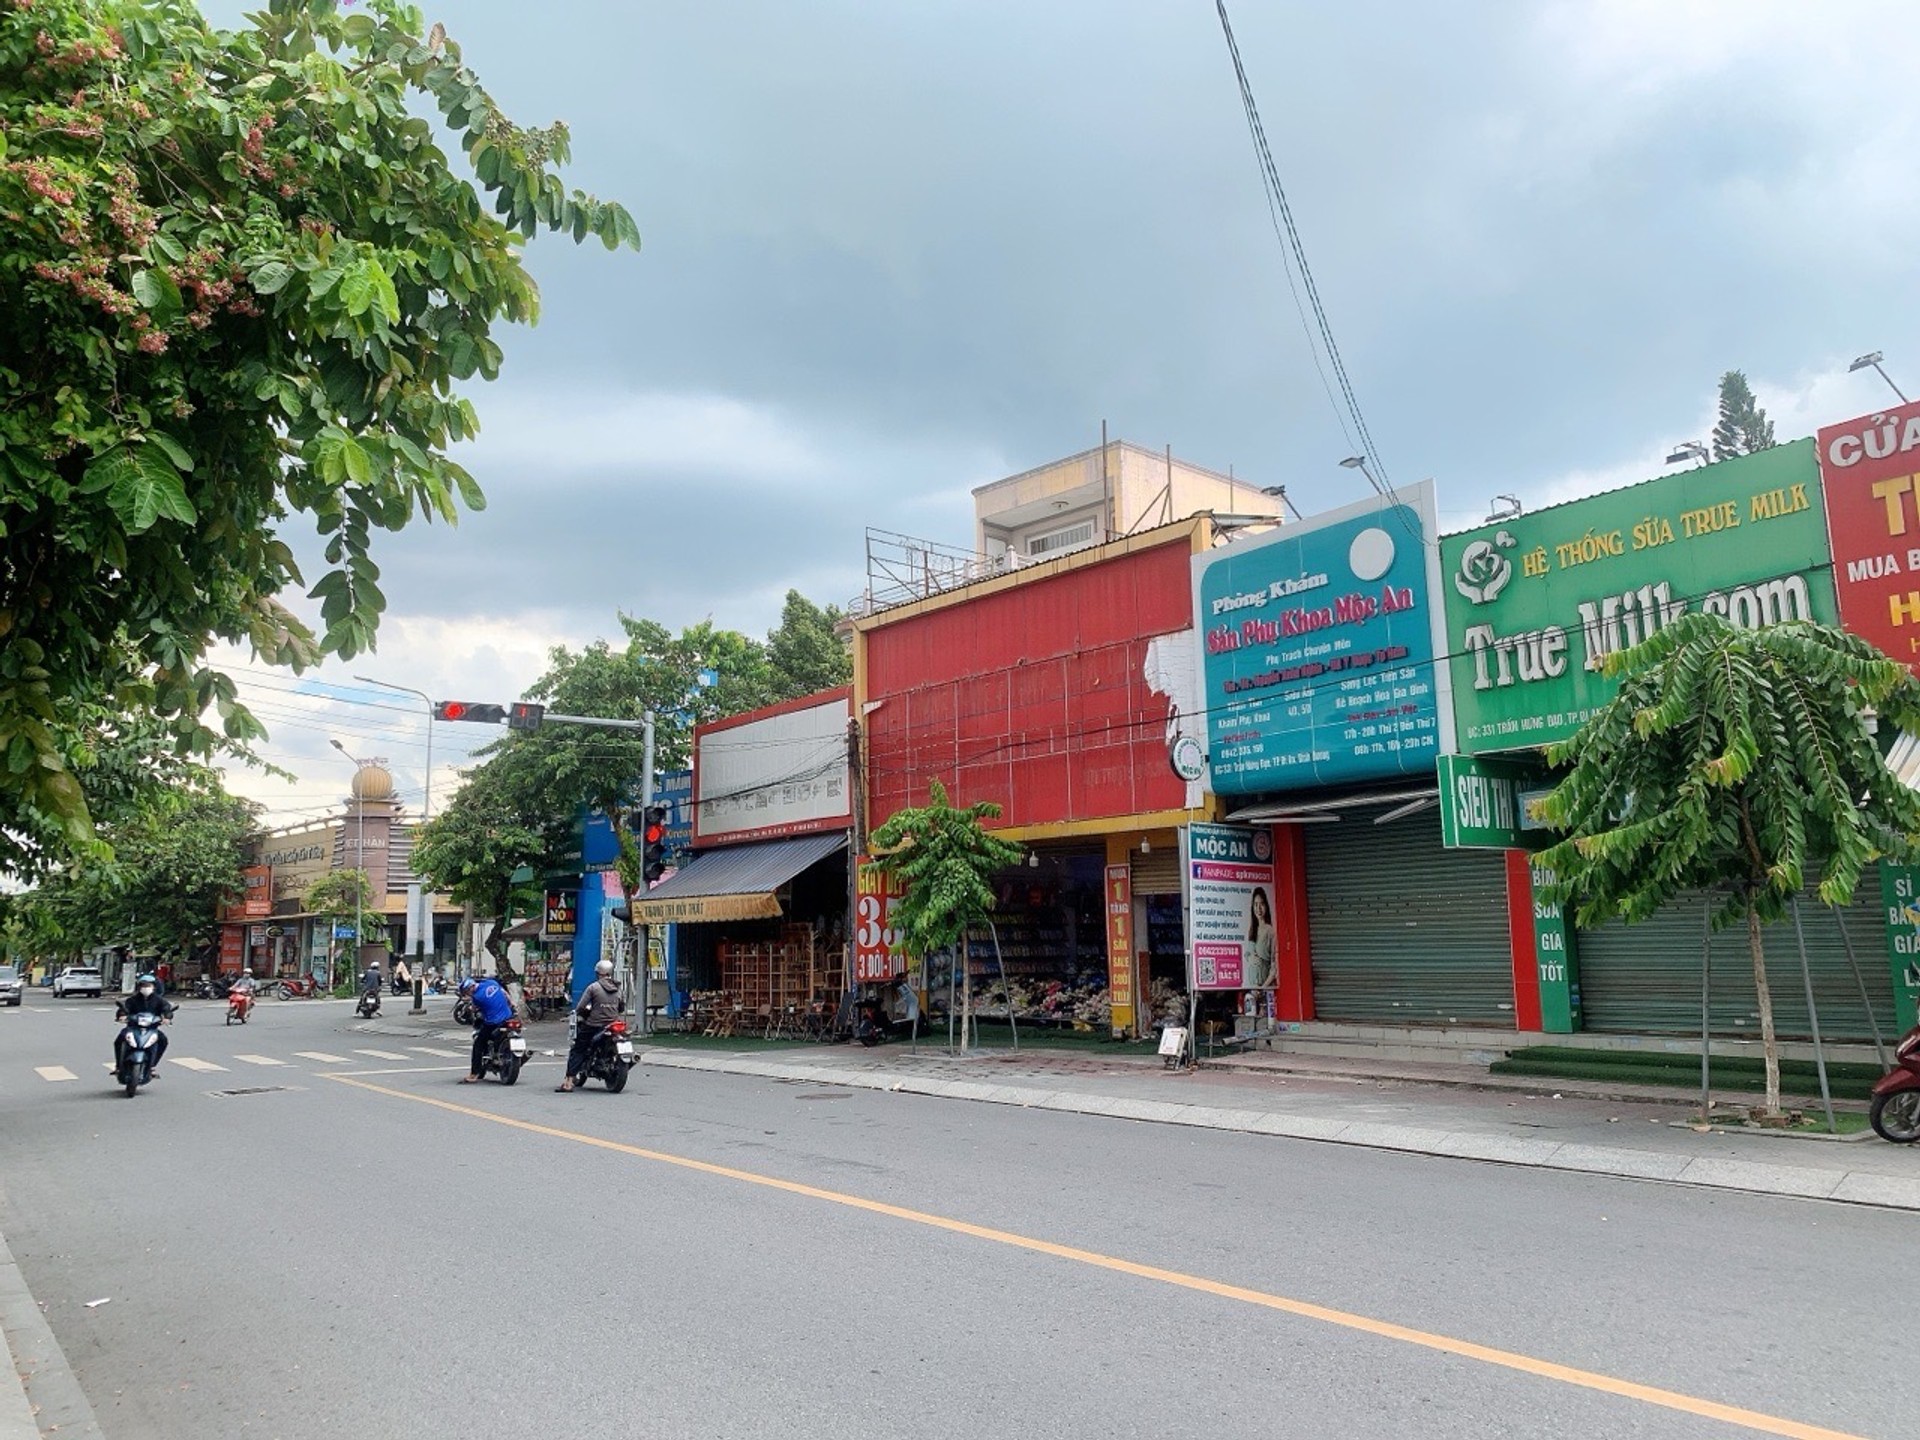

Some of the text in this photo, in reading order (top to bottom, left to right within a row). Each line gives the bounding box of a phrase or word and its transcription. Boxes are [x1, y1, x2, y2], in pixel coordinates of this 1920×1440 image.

[1522, 483, 1810, 579] HỆ THỐNG SỮA TRUE MILK
[1847, 553, 1901, 583] MUA
[1269, 571, 1328, 599] Khám
[1281, 608, 1334, 636] Khoa
[1335, 592, 1377, 626] Mộc
[1382, 584, 1414, 613] An
[1465, 623, 1567, 690] True
[1458, 765, 1490, 829] SIÊU
[1196, 835, 1248, 859] MỘC AN
[1113, 882, 1123, 900] 1
[1115, 916, 1125, 937] 1
[1541, 930, 1563, 951] GIÁ
[859, 954, 866, 978] 3
[1540, 959, 1564, 982] TỐT
